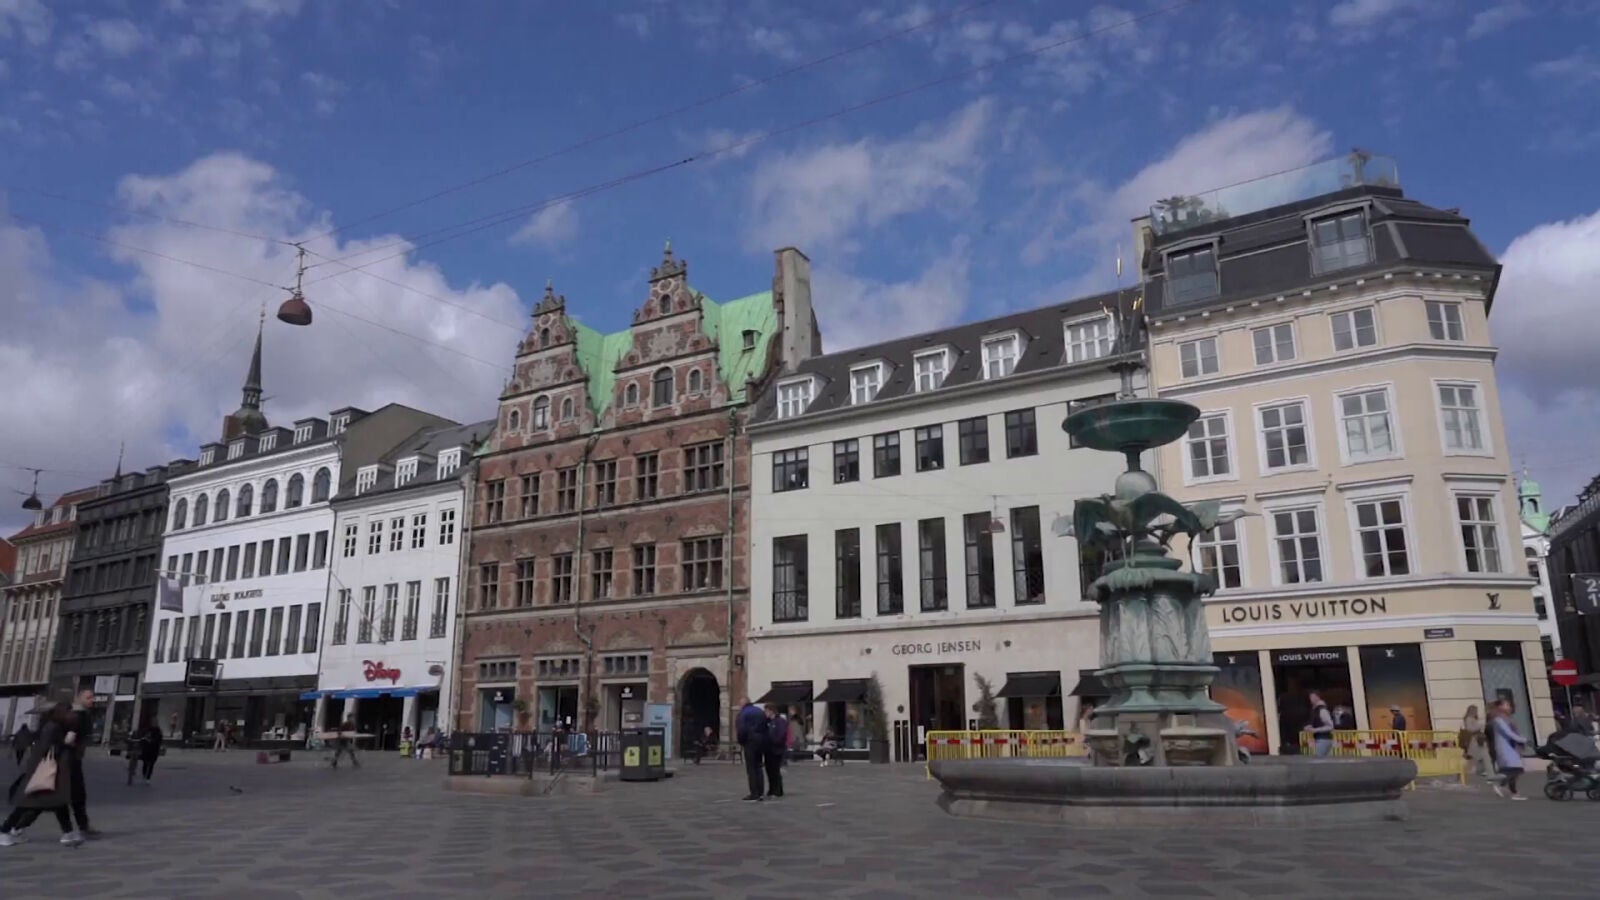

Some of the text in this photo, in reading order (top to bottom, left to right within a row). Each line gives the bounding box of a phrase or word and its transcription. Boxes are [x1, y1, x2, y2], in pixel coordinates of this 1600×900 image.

[1585, 578, 1600, 592] 2
[1587, 592, 1600, 607] 1
[1222, 597, 1387, 623] LOUIS VUITTON
[891, 640, 981, 656] GEORG JENSEN
[1278, 652, 1340, 662] LOUIS VUITTON
